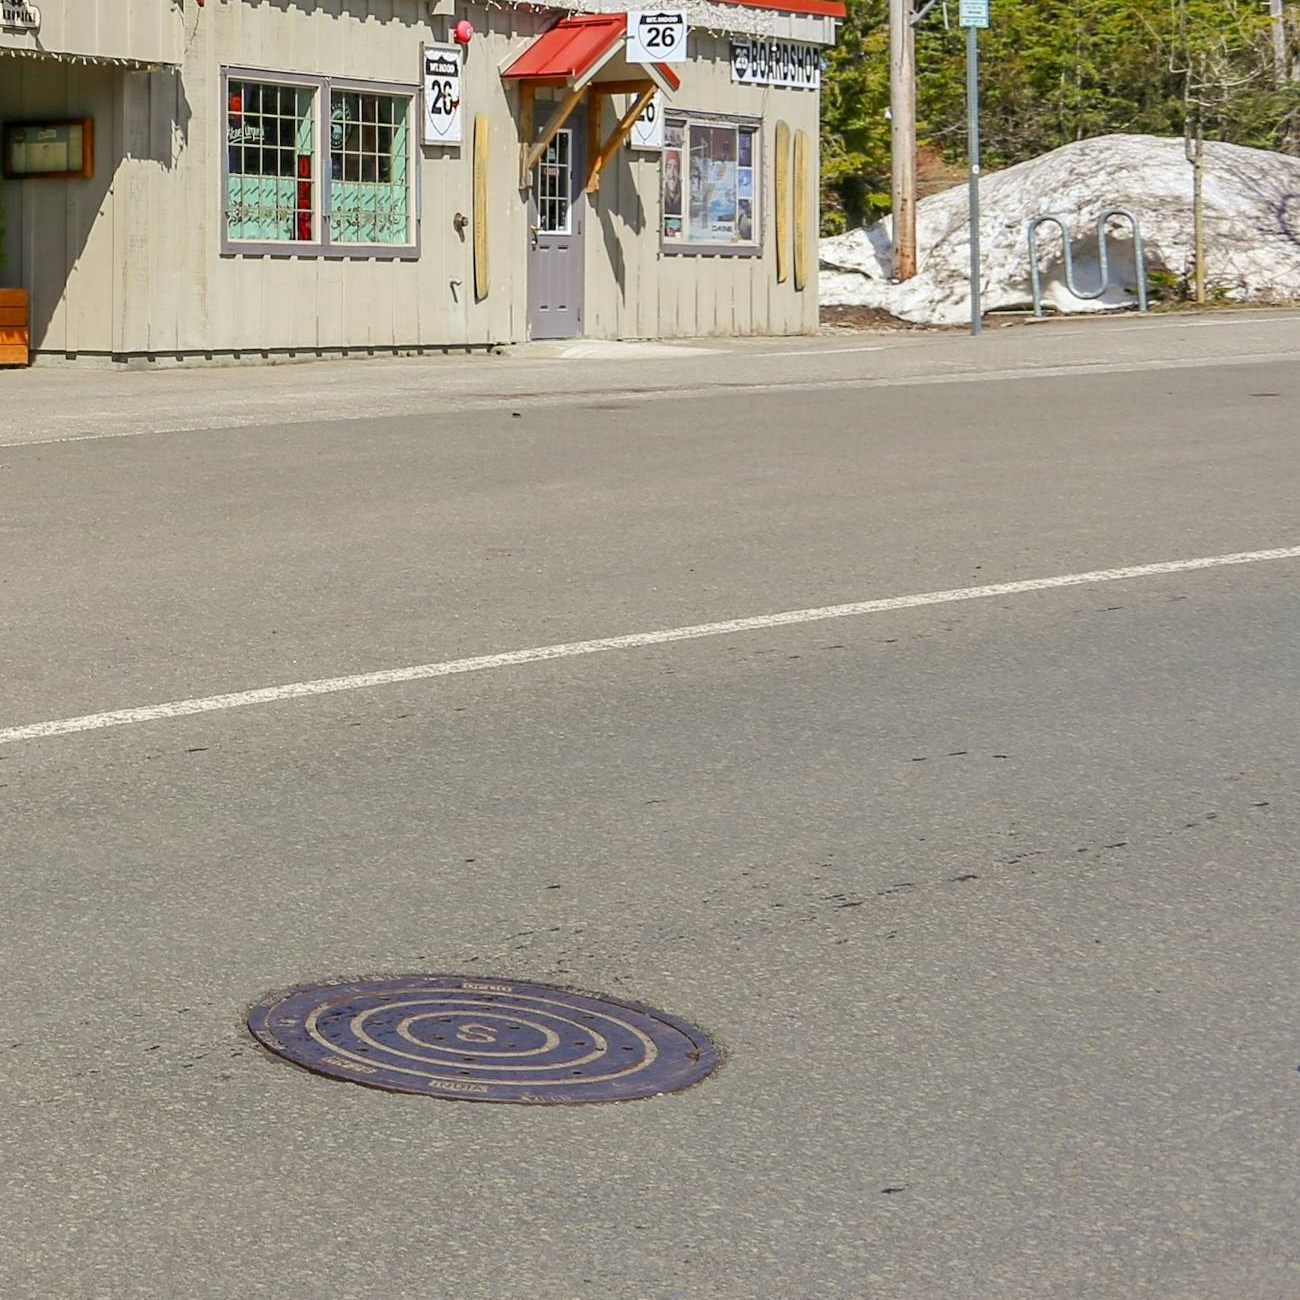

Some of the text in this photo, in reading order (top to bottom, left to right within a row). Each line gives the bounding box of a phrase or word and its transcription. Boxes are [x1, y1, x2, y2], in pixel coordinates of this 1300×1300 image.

[646, 27, 675, 47] 26
[751, 40, 819, 84] BOARDSHOP
[432, 80, 453, 115] 26
[456, 1023, 499, 1044] S
